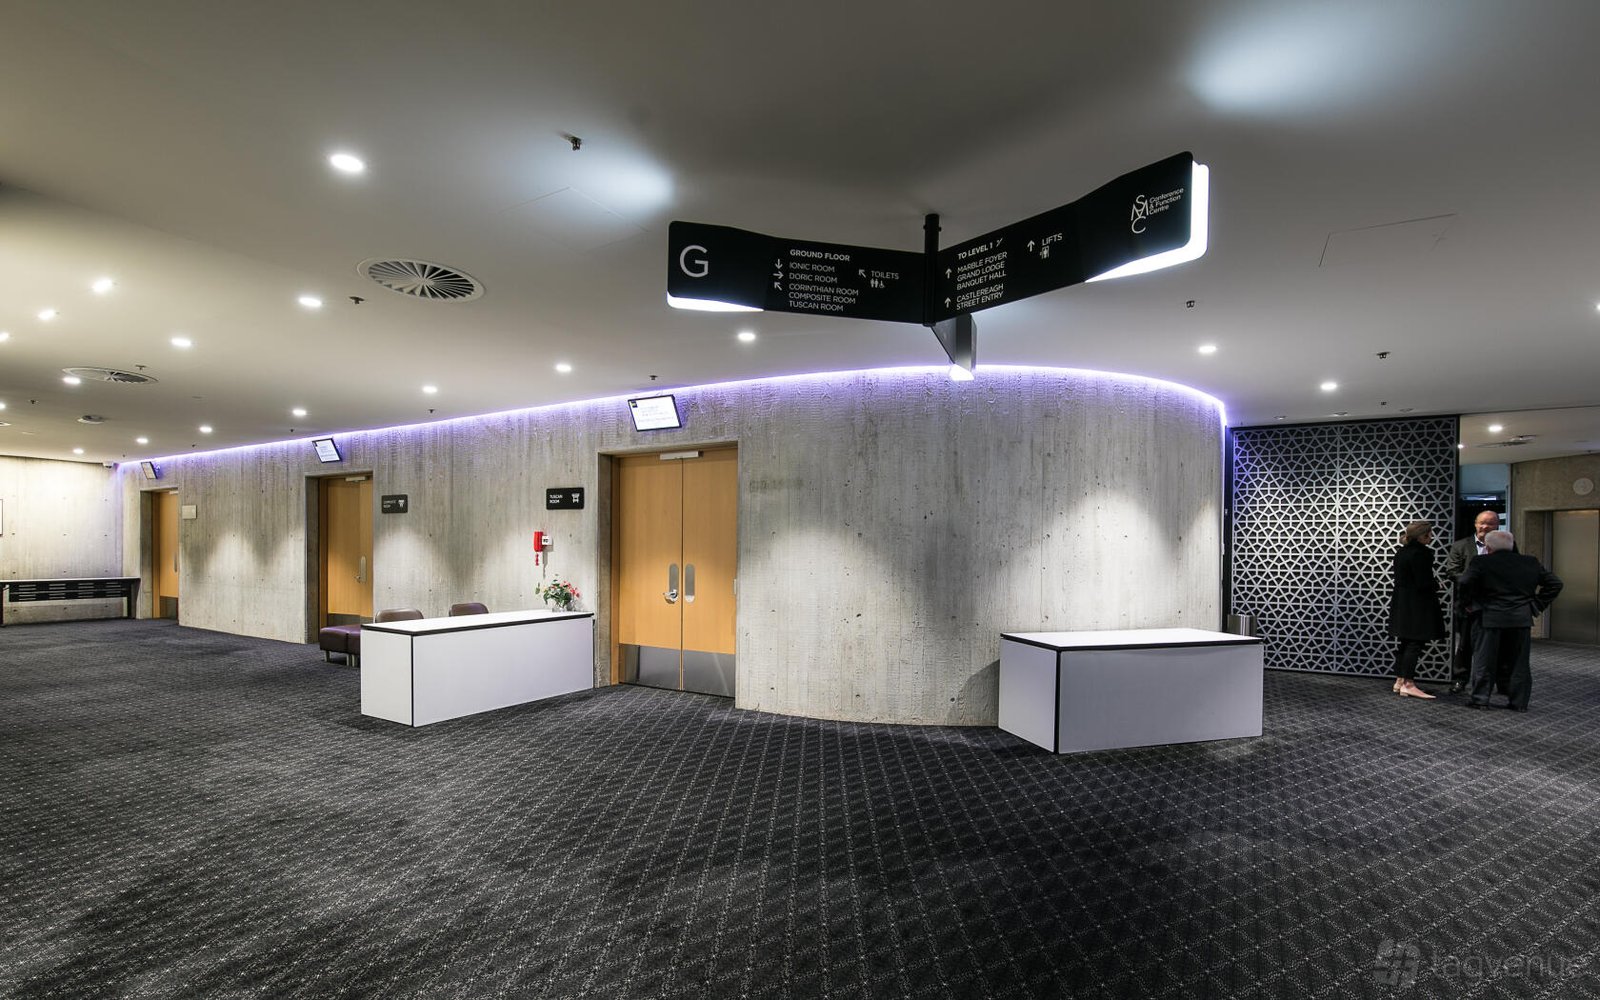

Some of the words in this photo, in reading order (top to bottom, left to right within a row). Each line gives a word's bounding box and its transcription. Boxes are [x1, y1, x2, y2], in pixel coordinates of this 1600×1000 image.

[1149, 188, 1184, 204] Conference
[1155, 194, 1182, 207] Function
[1149, 204, 1170, 215] Centre
[1041, 232, 1063, 246] LIFTS
[789, 249, 823, 259] GROUND
[824, 252, 851, 261] FLOOR
[957, 252, 967, 260] TO
[968, 246, 988, 257] LEVEL
[679, 244, 709, 278] G
[789, 262, 810, 271] IONIC
[811, 264, 835, 273] ROOM
[957, 259, 984, 273] MARBLE
[984, 251, 1008, 265] FOYER
[789, 272, 813, 281] DORIC
[814, 274, 838, 283] ROOM
[870, 270, 900, 280] TOILETS
[957, 268, 980, 282] GRAND
[981, 261, 1005, 274] LODGE
[956, 275, 988, 291] BANQUET
[988, 269, 1007, 282] HALL
[789, 283, 835, 294] CORINTHIAN
[836, 287, 859, 296] ROOM
[956, 283, 1004, 302] CASTLEREAGH
[788, 291, 831, 302] COMPOSITE
[833, 296, 856, 304] ROOM
[956, 297, 980, 310] STREET
[981, 291, 1004, 304] ENTRY
[789, 300, 819, 309] TUSCAN
[820, 303, 844, 311] ROOM
